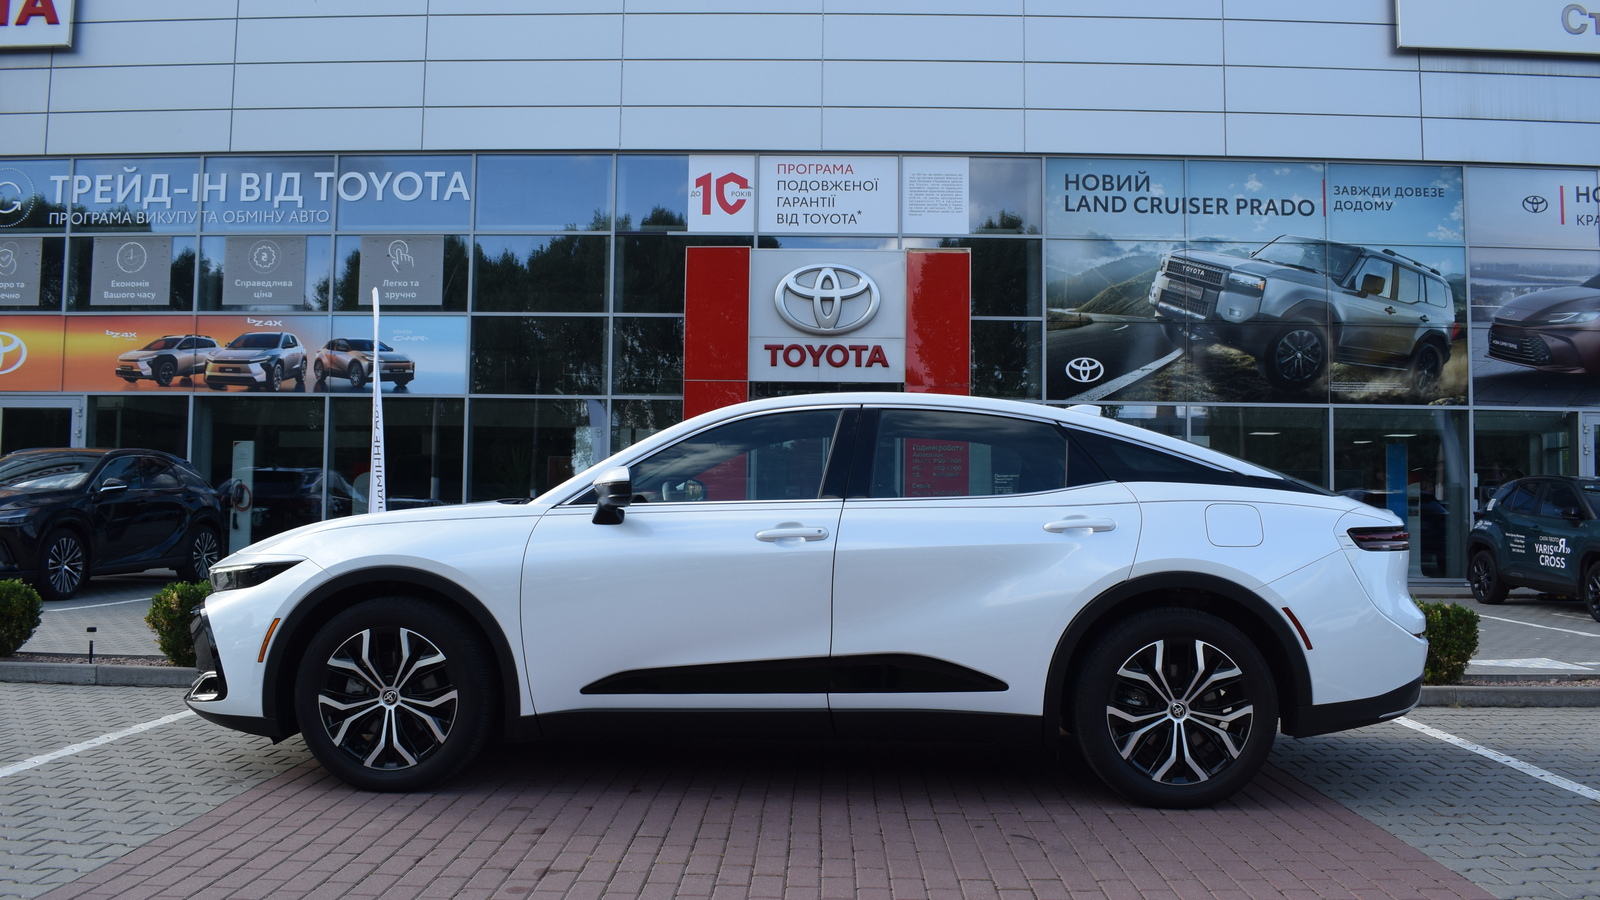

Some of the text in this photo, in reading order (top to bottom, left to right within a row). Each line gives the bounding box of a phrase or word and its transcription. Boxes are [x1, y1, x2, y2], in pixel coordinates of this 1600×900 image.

[776, 163, 854, 175] ПРОГРАМА
[776, 178, 879, 193] ПОДОВЖЕНОЇ
[1064, 170, 1150, 193] НОВИЙ
[50, 166, 471, 210] ТРЕЙД-ІН ВІД TOYOTA
[690, 190, 752, 198] ДО РОКІВ
[1333, 185, 1445, 199] ЗАВЖДИ ДОВЕЗЕ
[776, 194, 836, 208] ГАРАНТІЇ
[1064, 195, 1316, 217] LAND CRUISER PRADO
[1333, 200, 1394, 212] ДОДОМУ
[49, 209, 330, 225] ПРОГРАМА ВИКУПУ ТА ОБМІНУ АВТО
[776, 213, 799, 226] ВІД
[1182, 265, 1205, 276] TOYOTA
[110, 279, 149, 288] Економія
[234, 279, 293, 289] Справедлива
[382, 279, 408, 288] Легко
[103, 291, 157, 300] Вашого часу
[253, 290, 273, 299] ціна
[384, 291, 417, 300] зручно
[764, 344, 890, 368] TOYOTA
[1534, 543, 1554, 555] YARIS
[1539, 554, 1566, 569] CROSS
